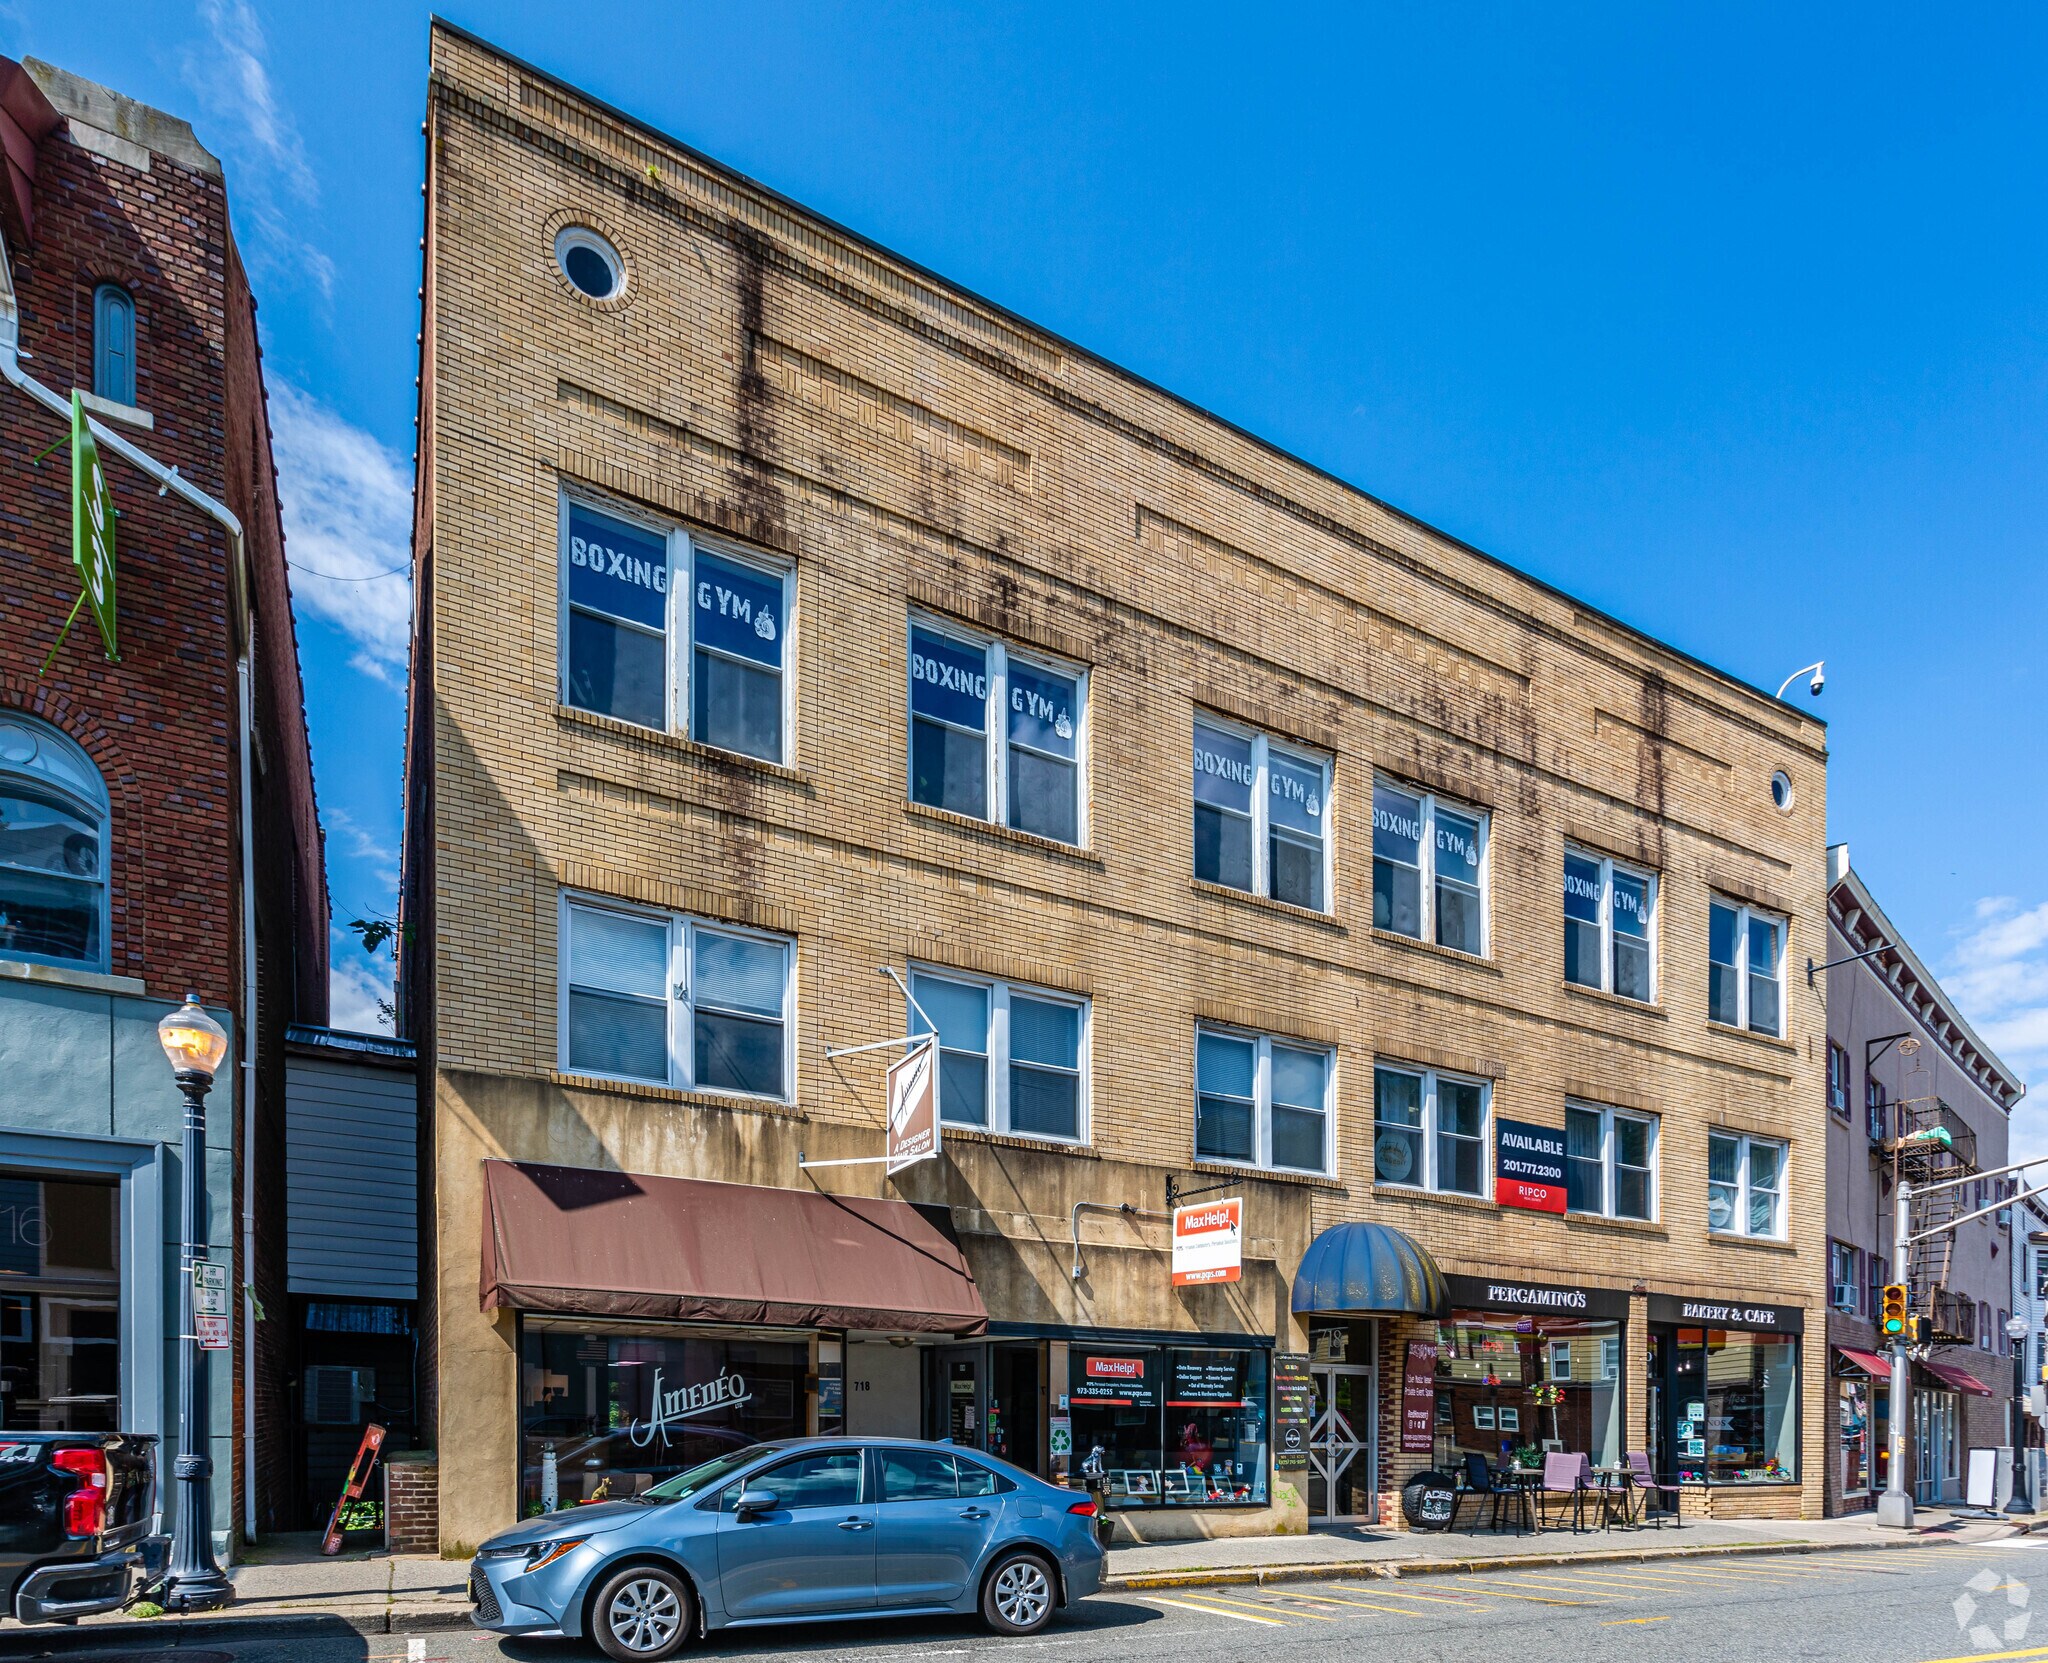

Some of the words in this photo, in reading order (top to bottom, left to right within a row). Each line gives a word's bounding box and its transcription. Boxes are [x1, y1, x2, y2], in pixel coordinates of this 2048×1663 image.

[571, 536, 667, 594] BOXING
[698, 581, 751, 625] GYM
[912, 653, 986, 700] BOXING
[1011, 687, 1054, 723] GYM
[1194, 748, 1252, 786] BOXING
[1271, 773, 1304, 803] GYM
[1373, 807, 1420, 841] BOXING
[1436, 829, 1464, 856] GYM
[1614, 890, 1637, 913] GYM
[1501, 1132, 1563, 1156] AVAILABLE
[1503, 1159, 1562, 1179] 201.777.2300
[1518, 1185, 1547, 1199] RIPCO
[0, 1205, 53, 1246] 16
[1185, 1209, 1229, 1230] MaxHelp!
[195, 1265, 202, 1285] 2
[1488, 1285, 1587, 1308] PERGAMINO'S
[1683, 1303, 1730, 1321] BAKERY
[1731, 1308, 1743, 1322] &
[1744, 1310, 1775, 1324] CAFE
[1095, 1361, 1135, 1375] MaxHelp!
[854, 1381, 870, 1392] 718
[1076, 1387, 1113, 1395] 973-335-0255
[0, 1441, 41, 1456] 71
[1424, 1490, 1453, 1501] ACES
[1422, 1510, 1451, 1520] BOXING
